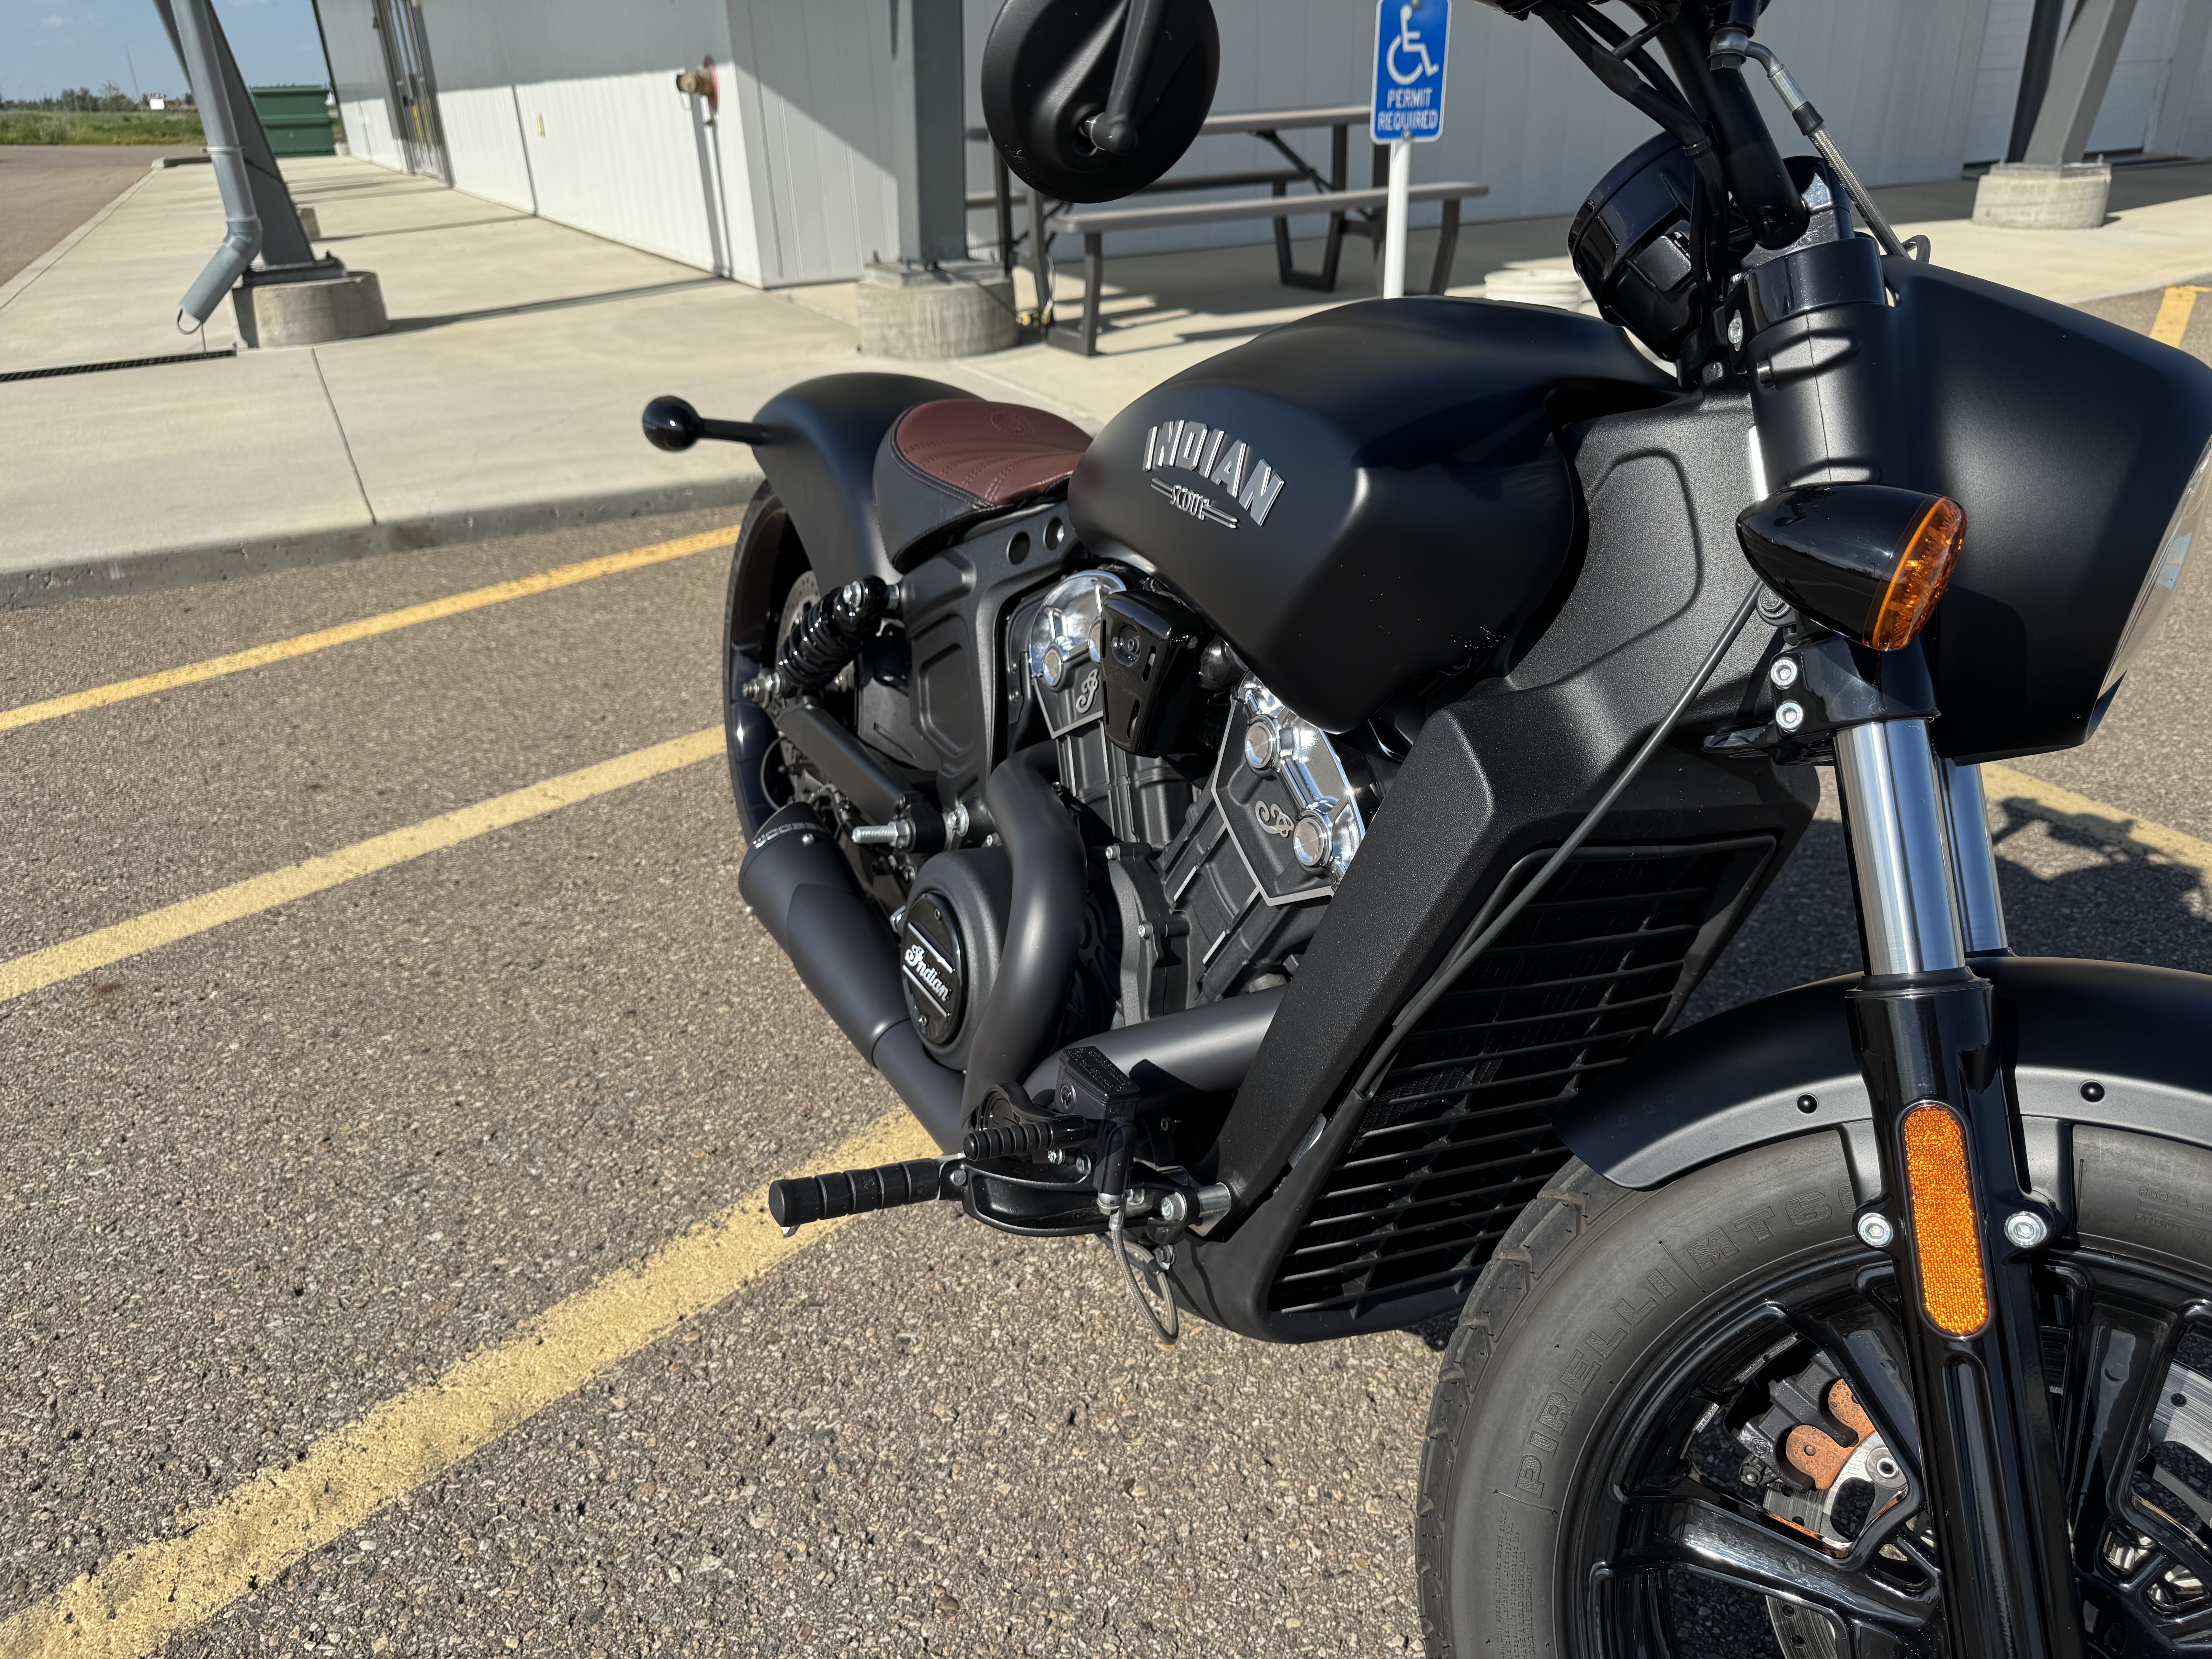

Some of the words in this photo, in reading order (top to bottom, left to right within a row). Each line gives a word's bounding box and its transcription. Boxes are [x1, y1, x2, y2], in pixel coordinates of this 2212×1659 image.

[1387, 87, 1432, 109] PERMIT
[1377, 109, 1438, 131] REQUIRED
[1142, 420, 1285, 527] INDIAN
[1170, 484, 1209, 520] SCOUT
[905, 944, 949, 1002] Indian
[2138, 1187, 2188, 1207] RUOTA
[1516, 1268, 1677, 1498] PIRELLI
